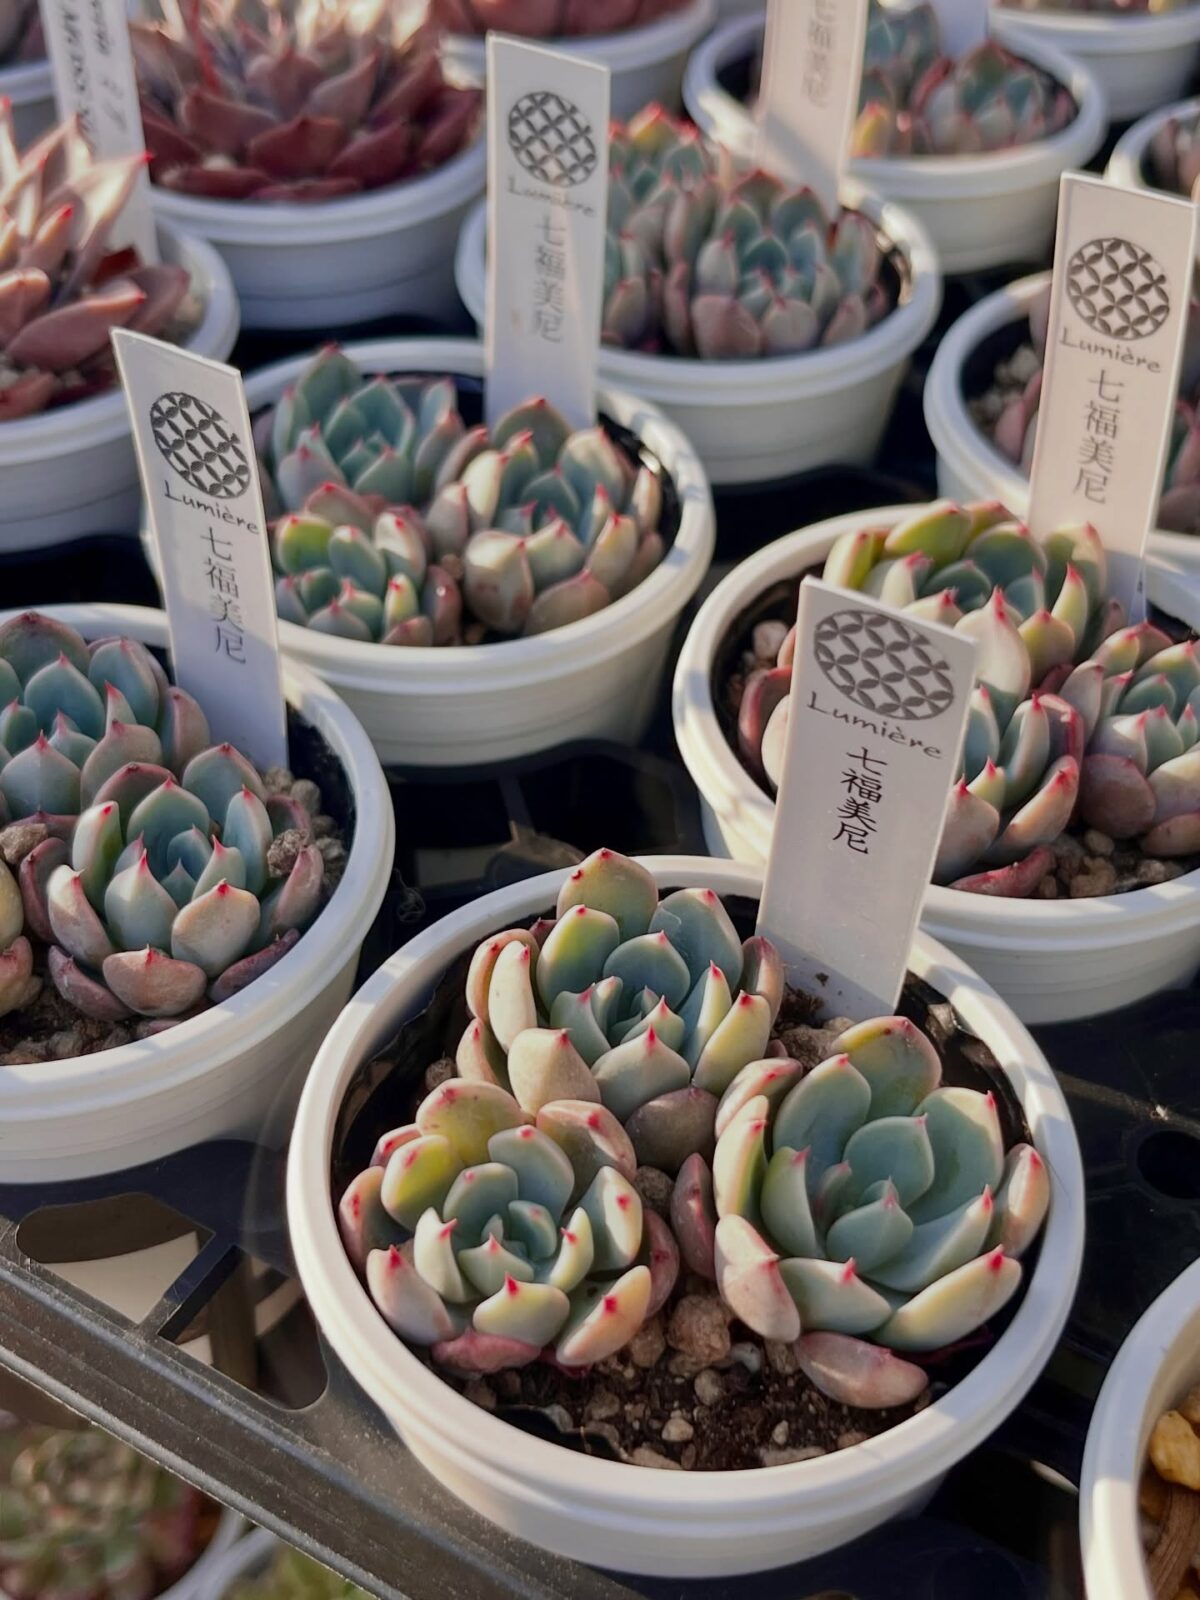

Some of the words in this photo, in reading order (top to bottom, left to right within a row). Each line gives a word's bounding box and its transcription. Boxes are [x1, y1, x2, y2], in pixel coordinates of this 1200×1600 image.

[1059, 326, 1162, 374] Lumière
[1073, 369, 1125, 505] 七福美尼
[163, 479, 260, 535] Lumière
[200, 526, 246, 664] 七福美尼
[806, 691, 943, 759] Lumière
[832, 746, 888, 855] 七福美尼
